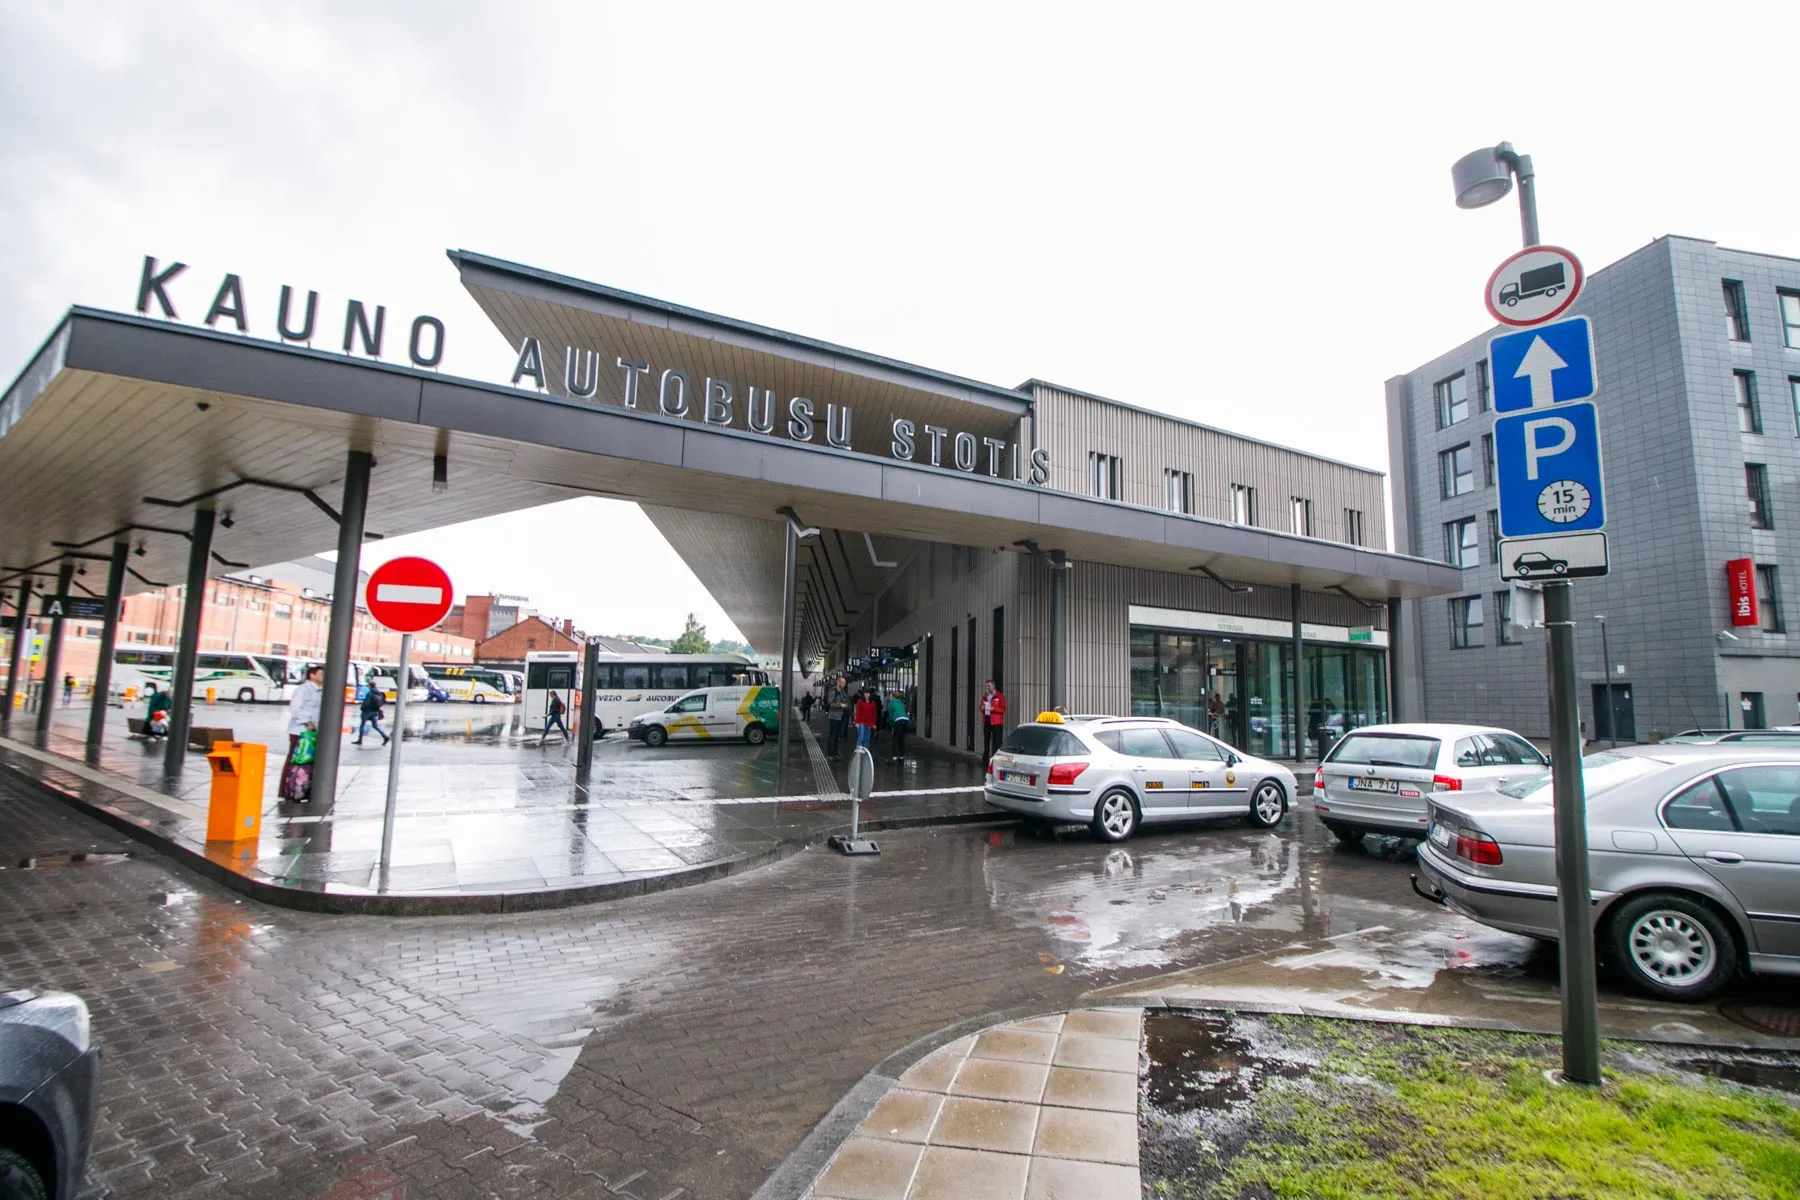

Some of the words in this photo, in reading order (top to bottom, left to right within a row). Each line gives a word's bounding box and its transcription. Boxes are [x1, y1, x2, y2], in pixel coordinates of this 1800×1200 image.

[136, 255, 446, 367] KAUNO
[891, 417, 1050, 486] STOTIS
[1523, 416, 1577, 480] P
[1553, 489, 1575, 505] 15
[1553, 503, 1576, 515] min
[1739, 570, 1749, 594] HOTEL
[48, 600, 64, 615] A
[1736, 596, 1751, 617] ibis
[871, 648, 879, 657] 21
[1354, 779, 1373, 789] JNA
[1379, 781, 1396, 790] 714
